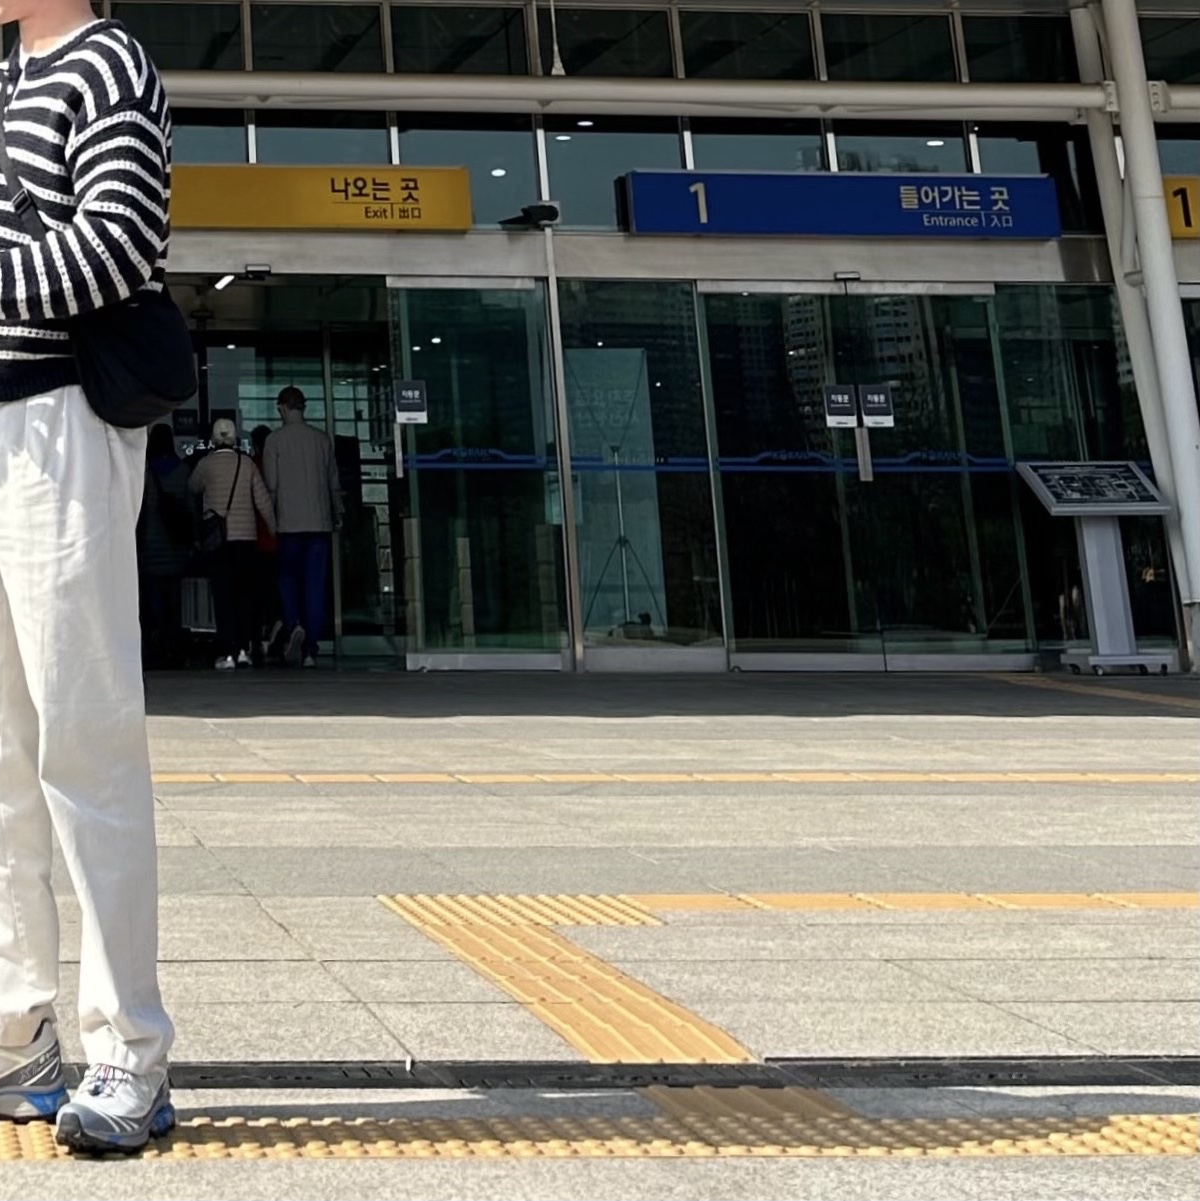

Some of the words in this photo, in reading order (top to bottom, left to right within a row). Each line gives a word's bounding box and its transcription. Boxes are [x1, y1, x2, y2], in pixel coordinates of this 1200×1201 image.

[330, 176, 390, 201] 나오는
[400, 177, 419, 202] 곳
[899, 185, 981, 209] 들어가는
[990, 186, 1010, 211] 곳
[364, 206, 388, 219] Exit
[398, 206, 421, 219] 出口
[689, 182, 708, 224] 1
[1172, 187, 1193, 228] 1
[923, 213, 979, 227] Entrance
[991, 215, 1013, 227] 入口
